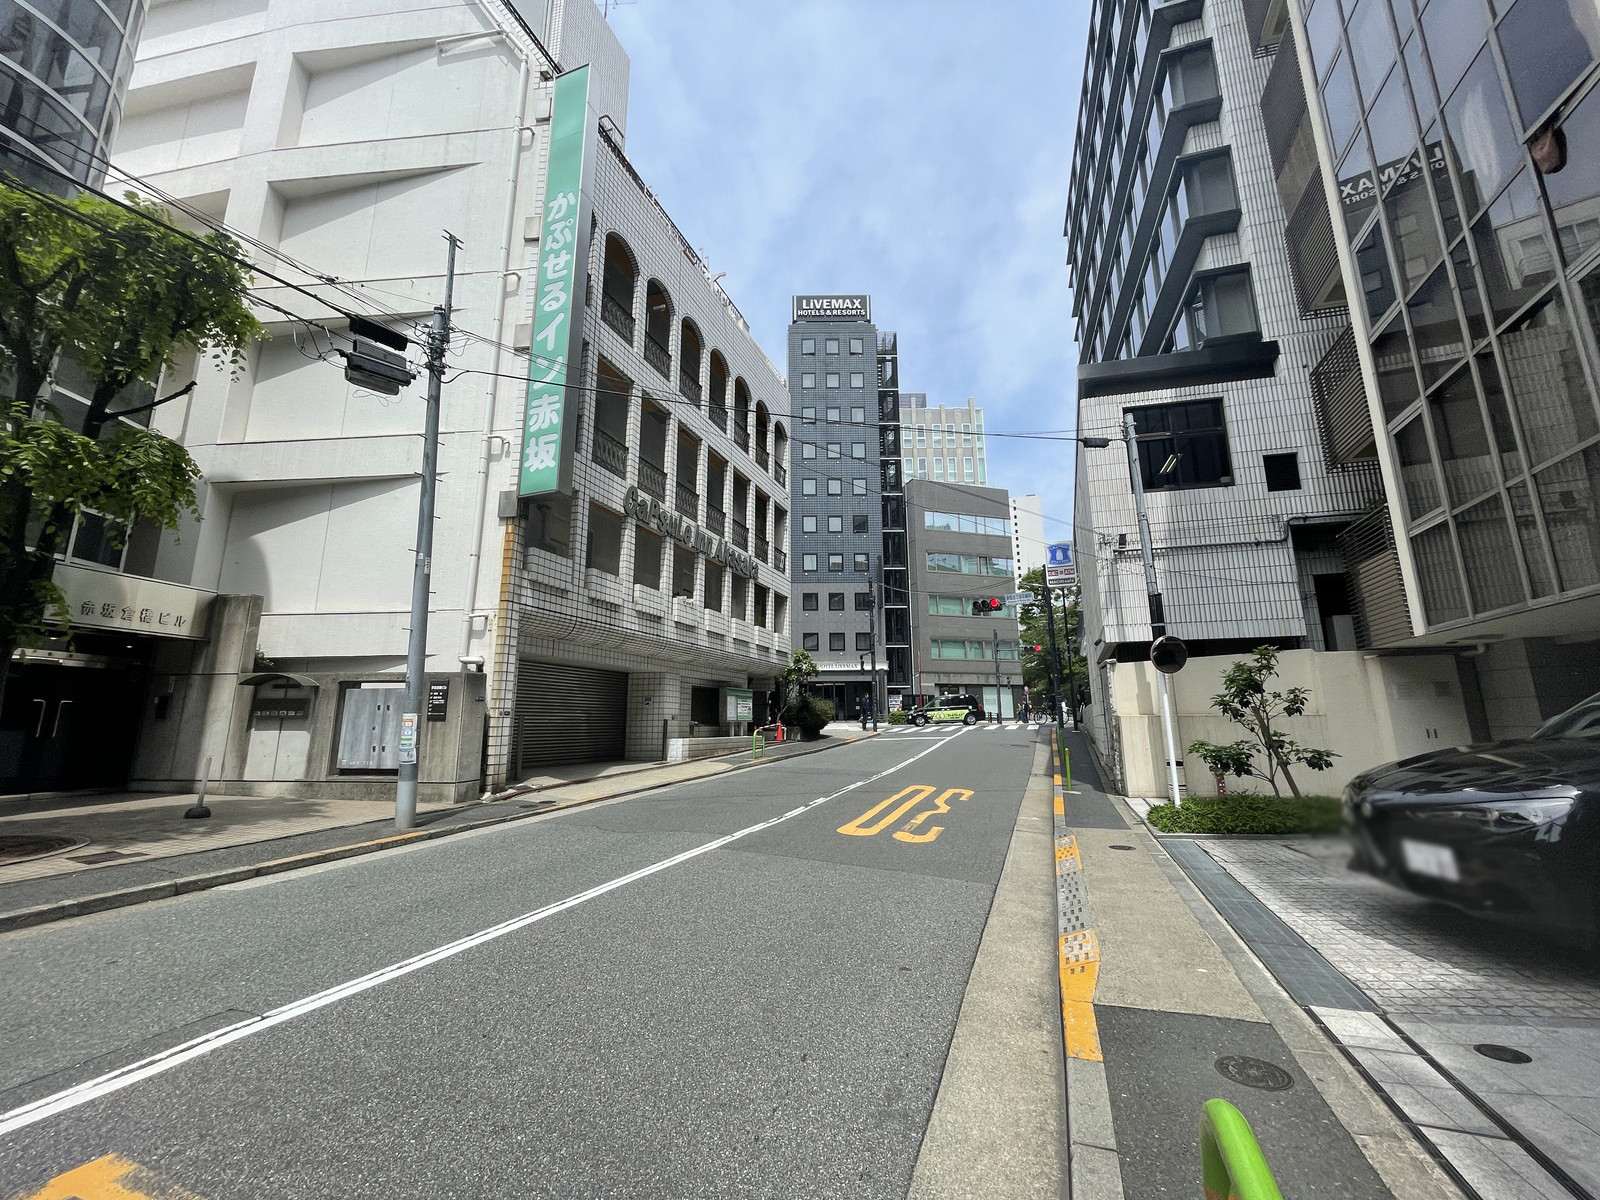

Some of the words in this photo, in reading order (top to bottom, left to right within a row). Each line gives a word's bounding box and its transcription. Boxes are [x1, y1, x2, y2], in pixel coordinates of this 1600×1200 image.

[524, 191, 576, 473] かぷせるイン赤坂
